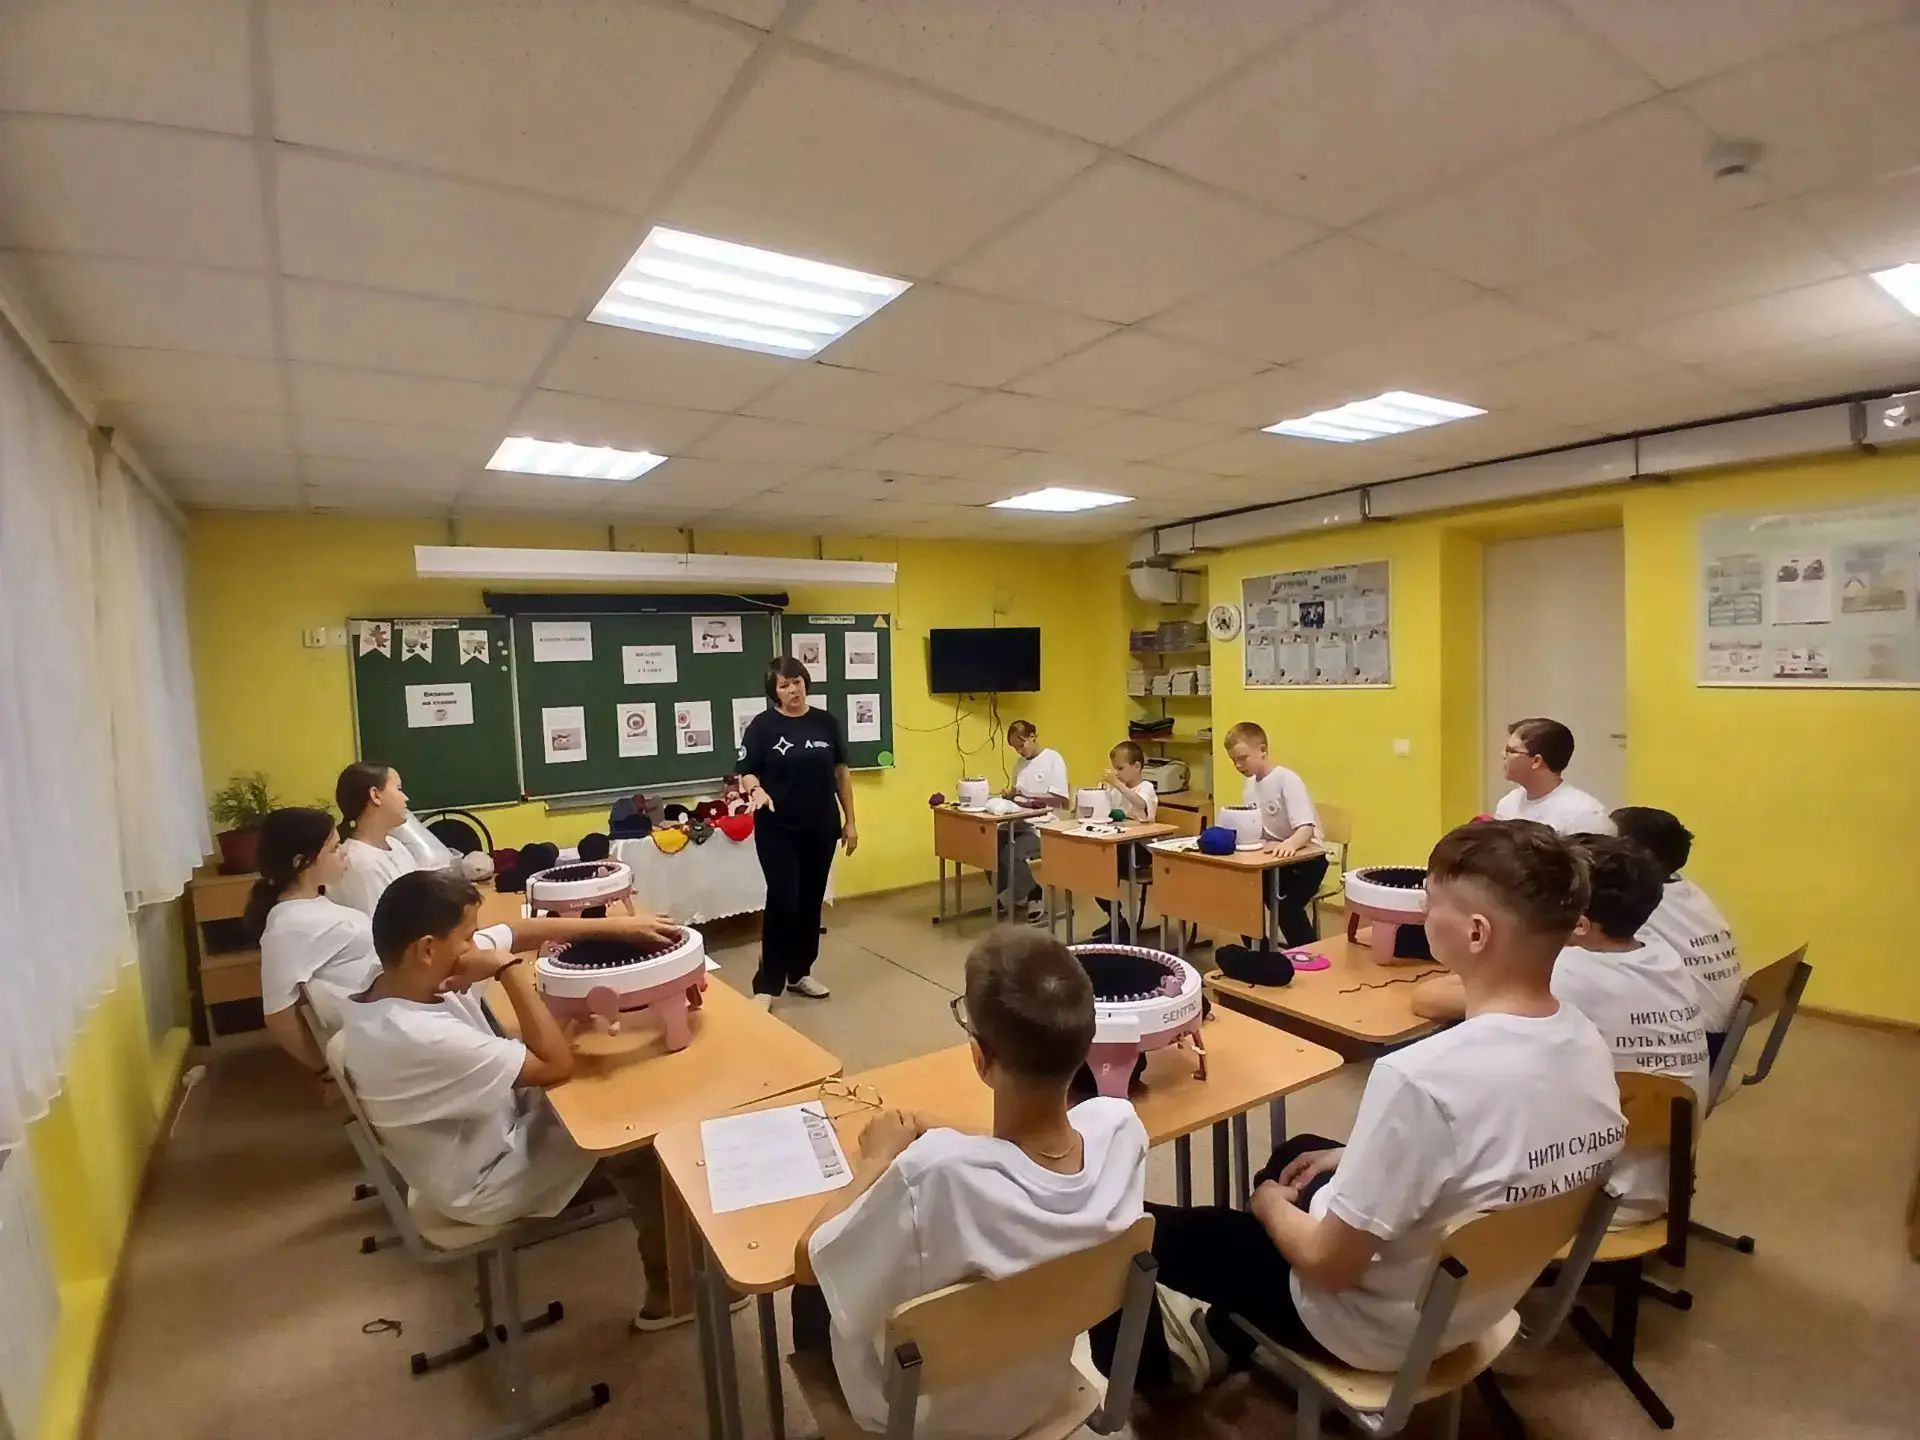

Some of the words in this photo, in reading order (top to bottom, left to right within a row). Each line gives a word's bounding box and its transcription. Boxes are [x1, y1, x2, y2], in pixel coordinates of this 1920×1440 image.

[1630, 1011, 1669, 1025] НИТИ
[1616, 1036, 1654, 1048] ПУТЬ
[1657, 1035, 1667, 1047] К
[1636, 1055, 1678, 1068] ЧЕРЕЗ
[1528, 1141, 1565, 1170] НИТИ
[1568, 1123, 1625, 1156] СУДЬБЫ
[1506, 1184, 1547, 1202] ПУТЬ
[1551, 1178, 1561, 1195] К
